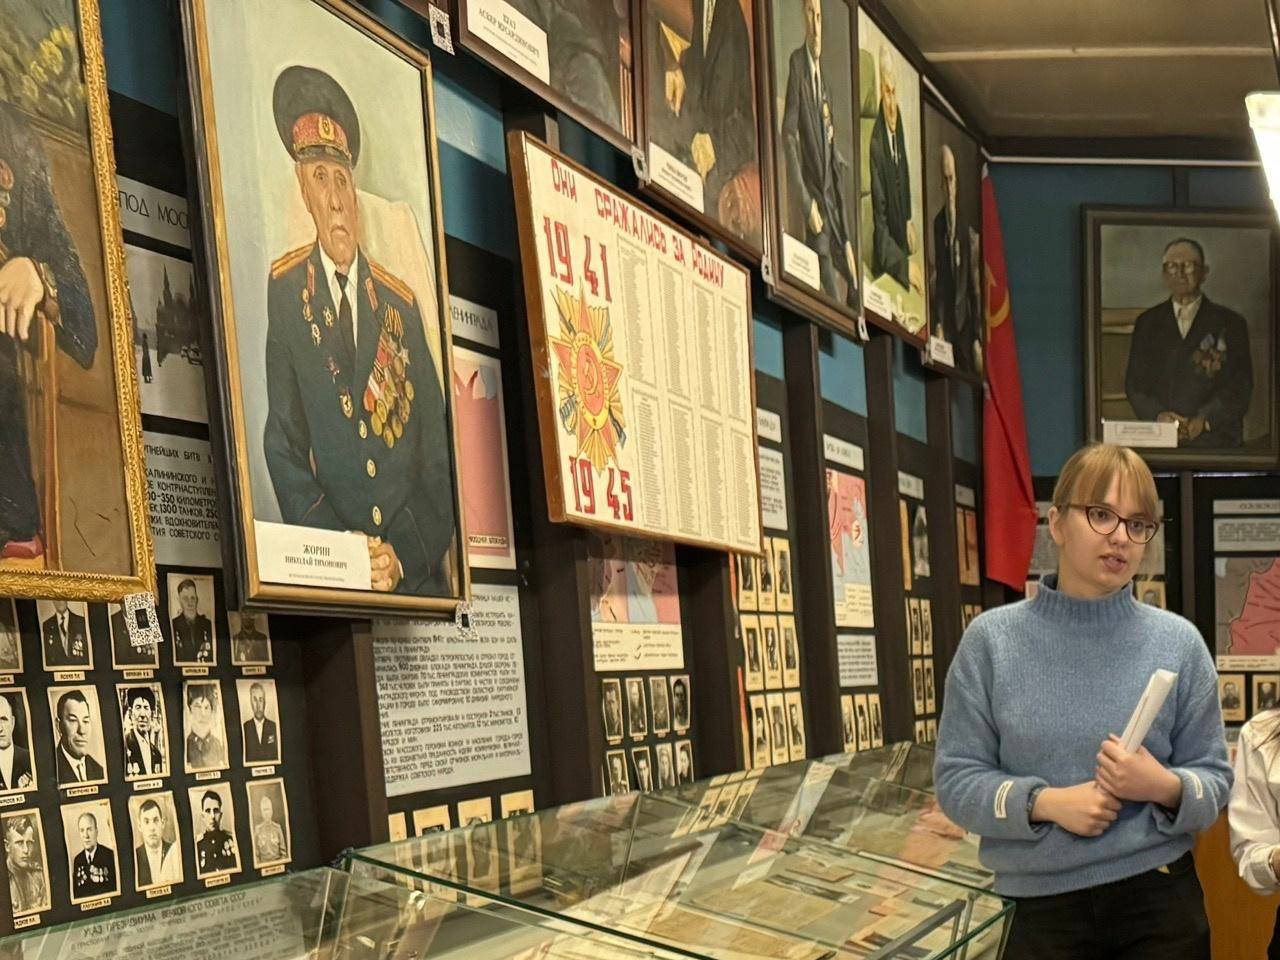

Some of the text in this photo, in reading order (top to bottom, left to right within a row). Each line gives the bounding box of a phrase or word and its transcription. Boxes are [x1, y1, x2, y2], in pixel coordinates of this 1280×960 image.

[118, 190, 150, 218] ПОД
[551, 158, 724, 288] ОНИ СРАЖАЛИСЬ ЗА РОДИНУ
[303, 544, 331, 557] ЖОРИН
